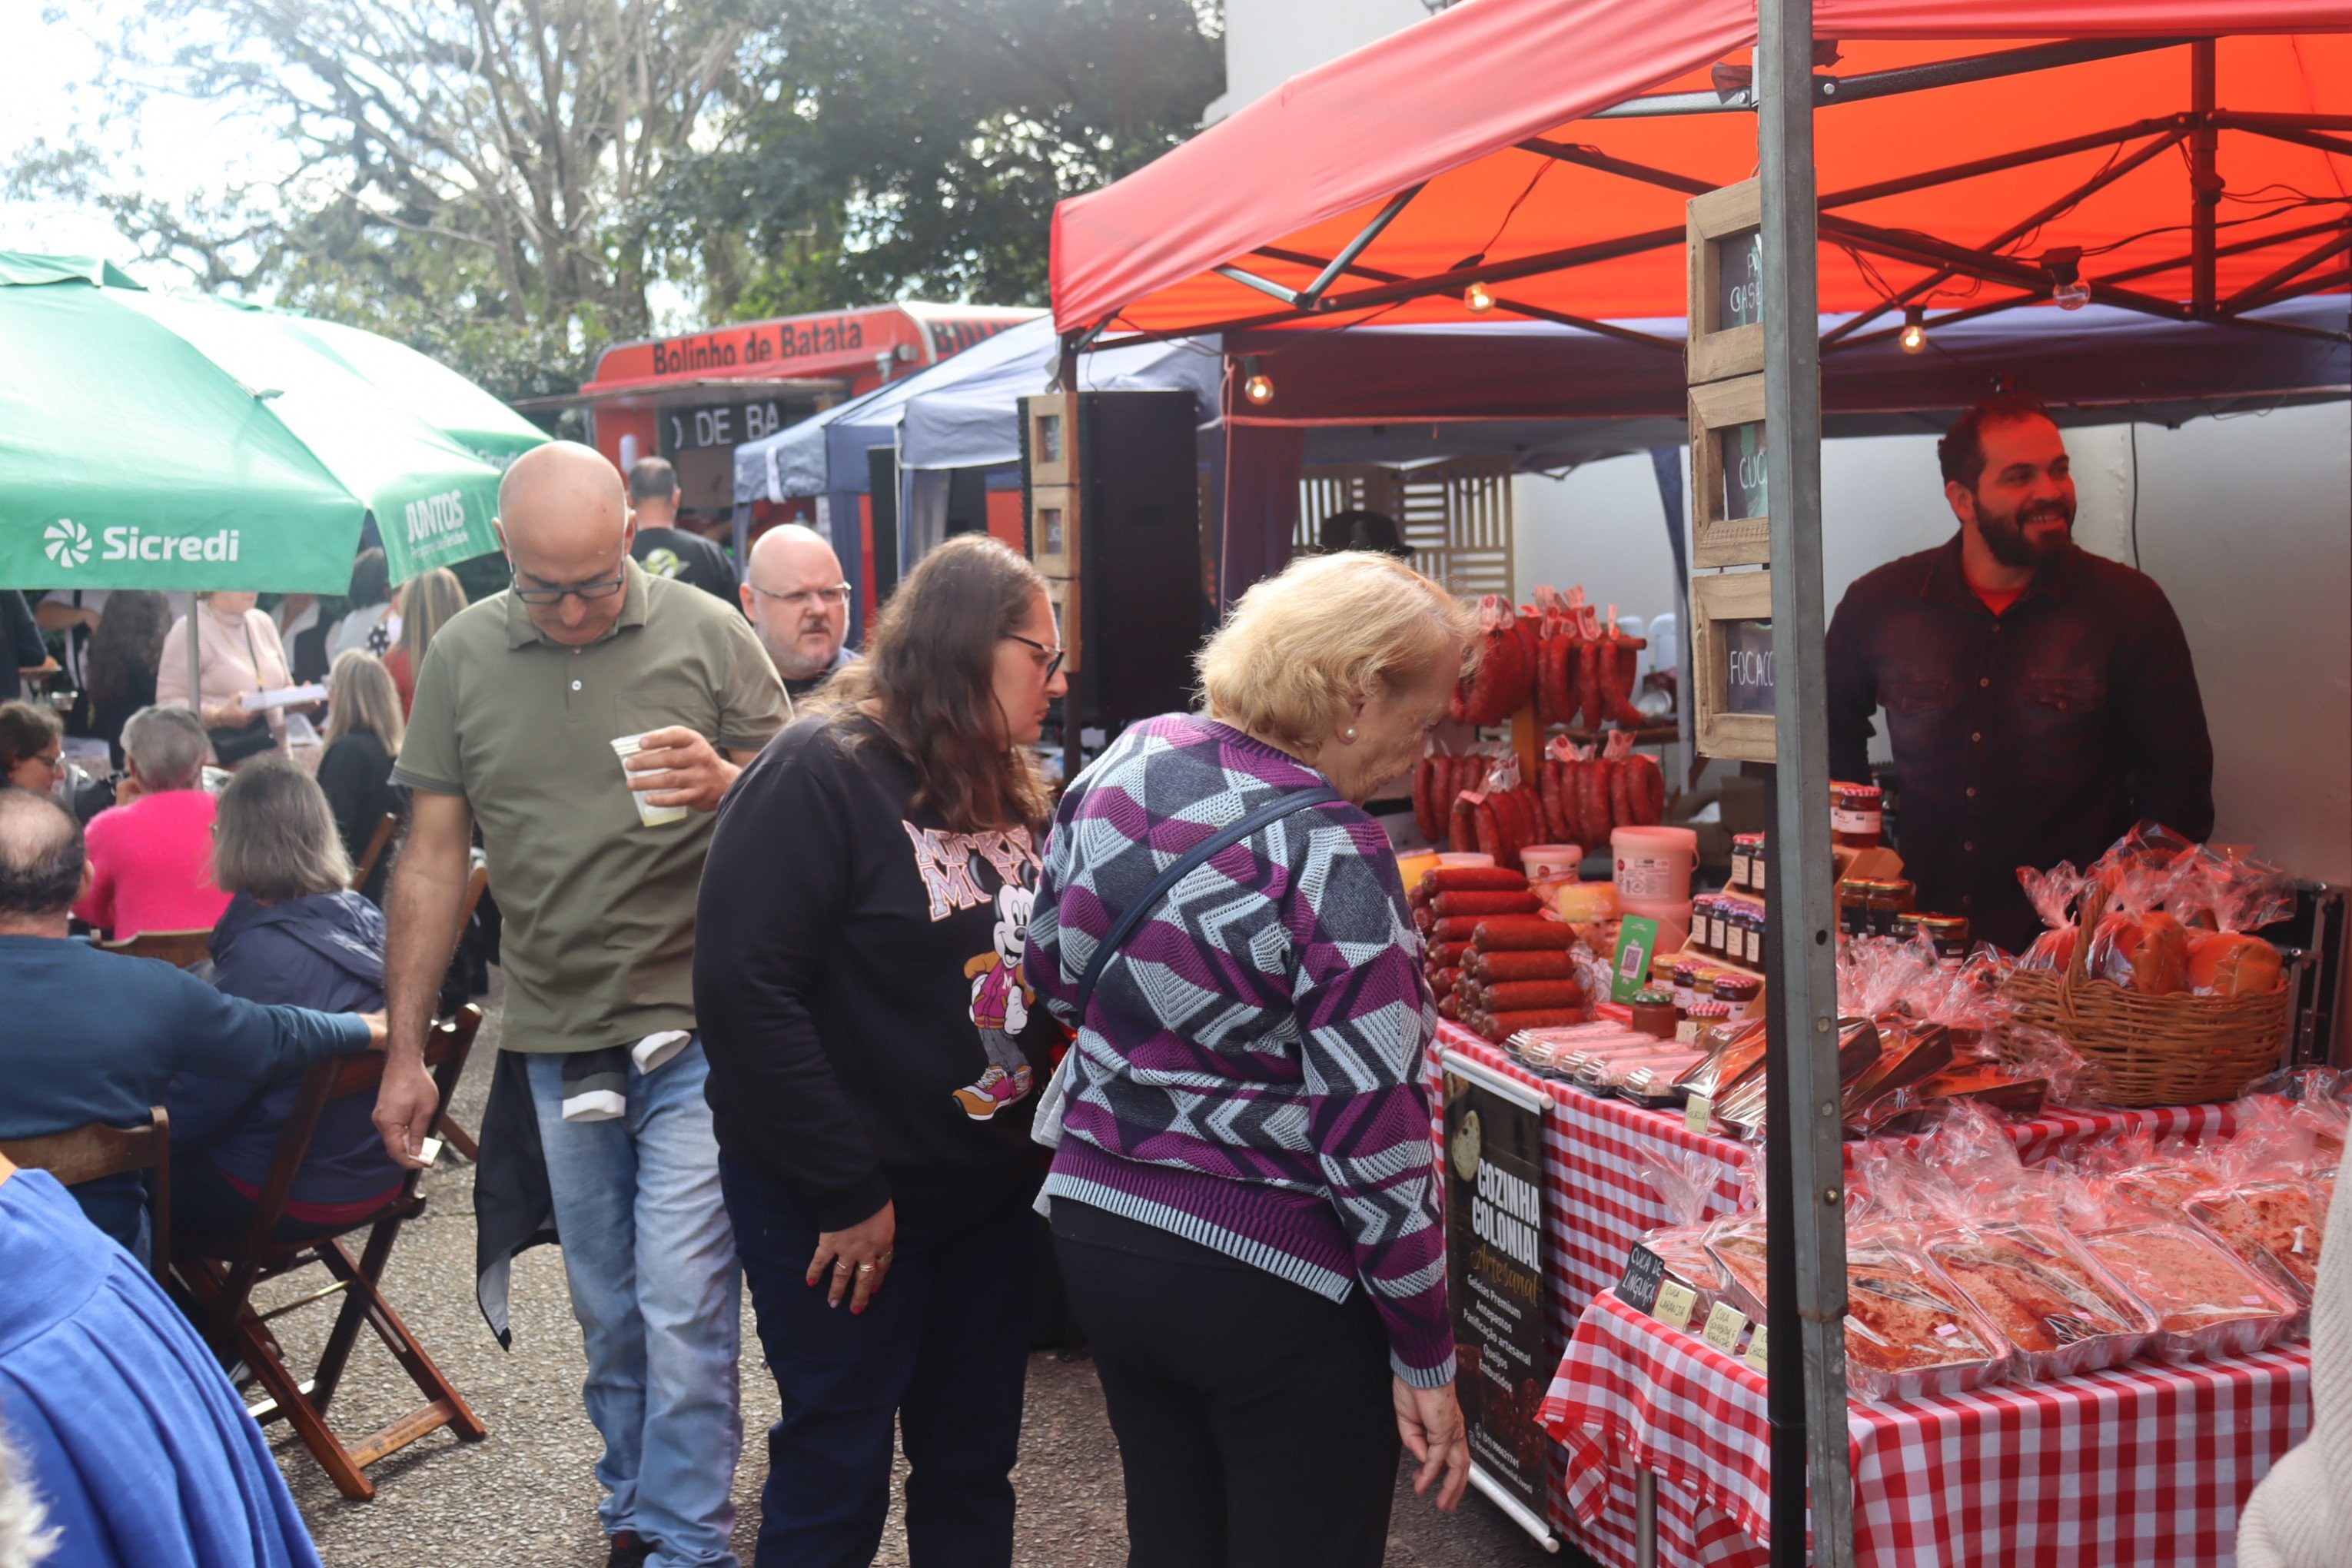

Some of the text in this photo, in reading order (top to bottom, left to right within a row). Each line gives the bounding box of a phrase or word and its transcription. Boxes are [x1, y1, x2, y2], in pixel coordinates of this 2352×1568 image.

[654, 317, 862, 375] Bolinho de Batata
[695, 408, 733, 447] DE
[1739, 451, 1767, 490] CUC
[405, 490, 465, 544] JUNTOS
[102, 526, 240, 562] Sicredi
[1477, 1157, 1541, 1230] COZINHA
[1472, 1195, 1542, 1274] COLONIAL
[1470, 1243, 1538, 1307] Artesanal
[1631, 1247, 1663, 1277] CUCA DE
[1476, 1299, 1513, 1334] Antepastos
[1490, 1289, 1521, 1321] Premium
[1483, 1344, 1508, 1370] Queijos
[1498, 1336, 1531, 1367] artesanal
[1479, 1357, 1513, 1393] Embutidos
